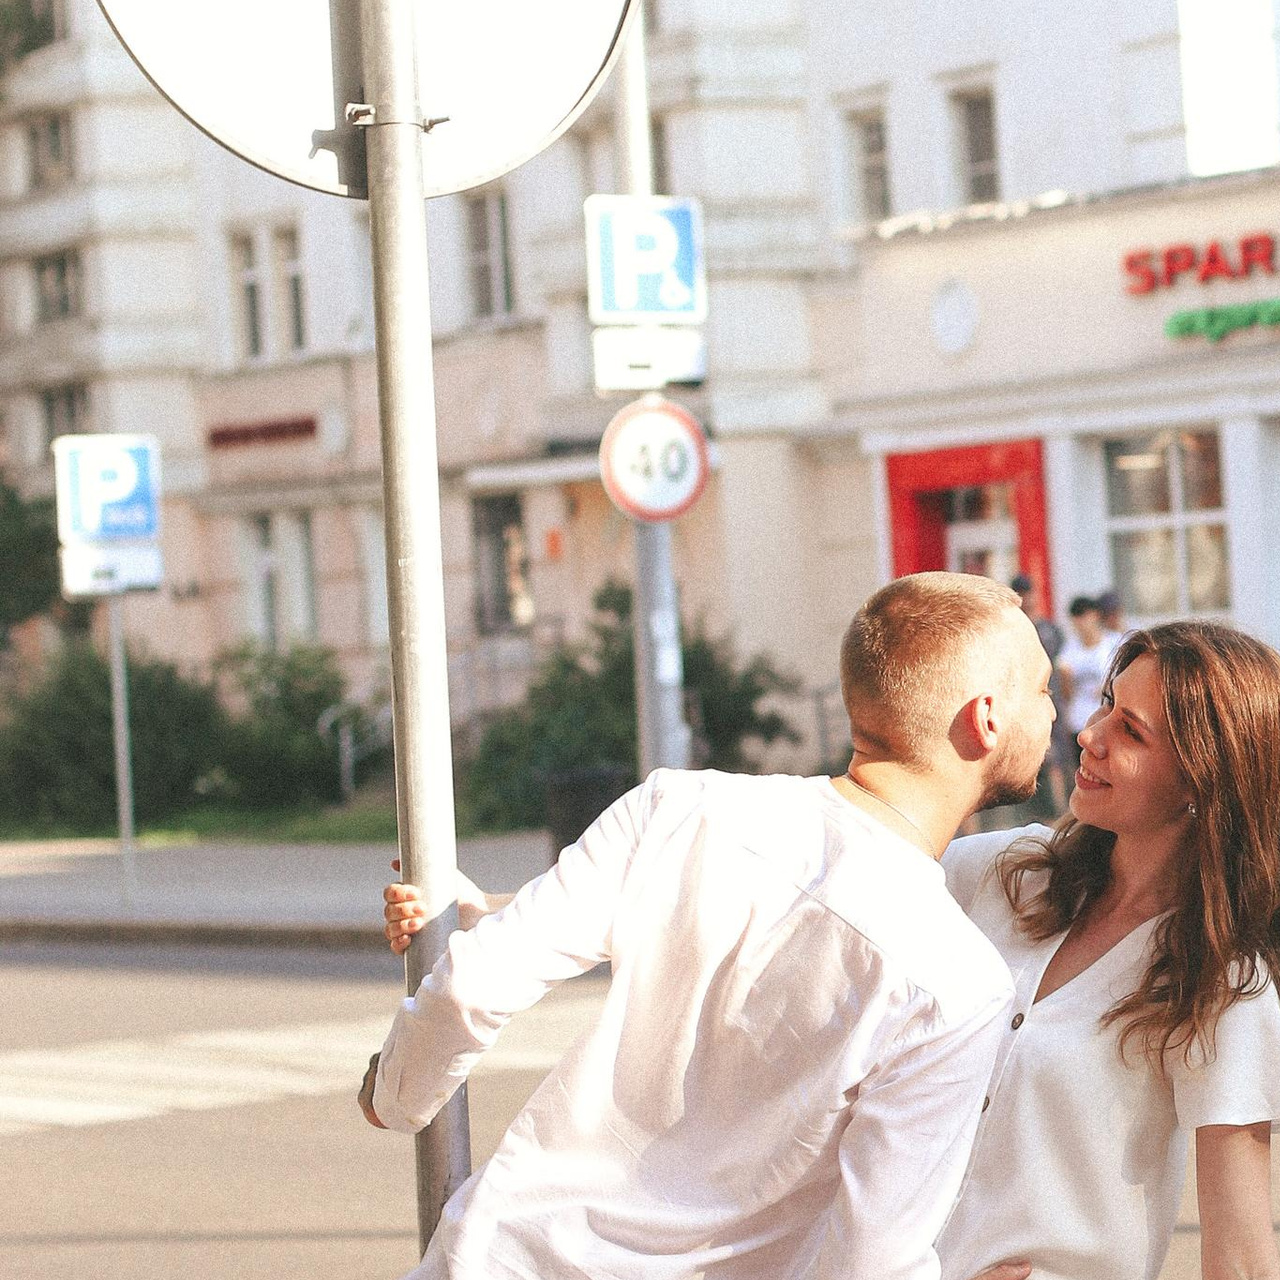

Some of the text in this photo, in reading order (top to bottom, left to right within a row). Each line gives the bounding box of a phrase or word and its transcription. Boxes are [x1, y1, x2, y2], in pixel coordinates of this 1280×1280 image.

[611, 211, 679, 310] P
[1121, 231, 1276, 297] SPAR
[77, 444, 139, 533] P
